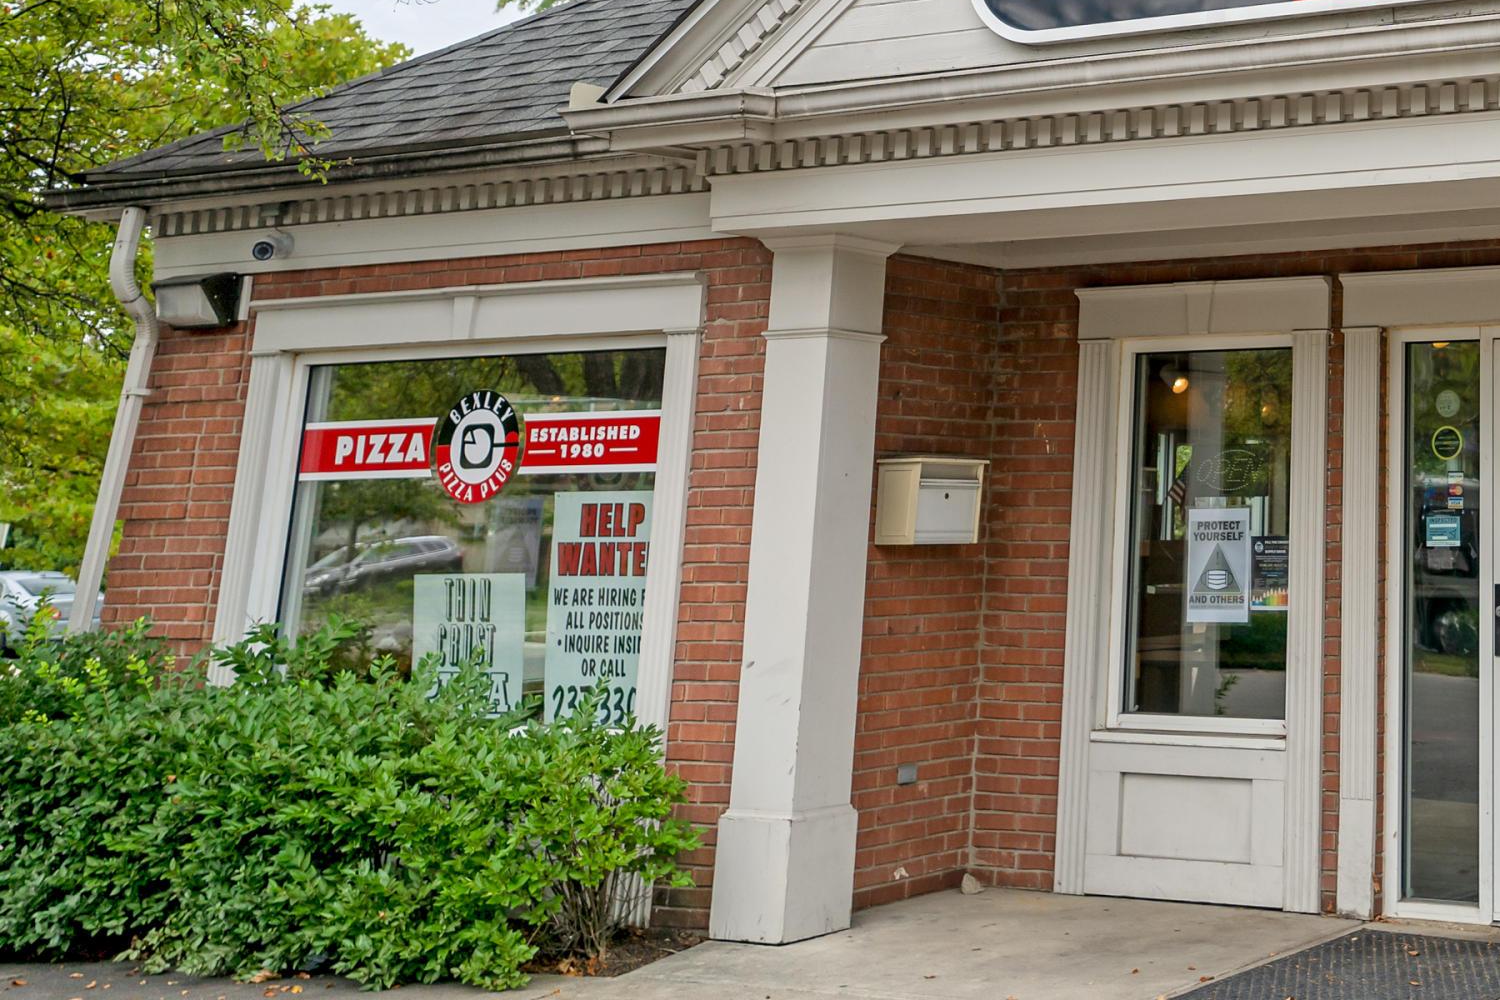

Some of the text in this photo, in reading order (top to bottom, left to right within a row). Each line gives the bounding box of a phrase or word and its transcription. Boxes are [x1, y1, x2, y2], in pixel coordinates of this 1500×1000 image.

[449, 391, 514, 425] BEXLEY
[529, 424, 641, 443] ESTABLISHED
[334, 432, 426, 466] PIZZA
[559, 442, 605, 459] 1980
[439, 458, 513, 502] PIZZA PLUS
[579, 502, 646, 538] HELP
[1197, 520, 1241, 531] PROTECT
[1193, 531, 1245, 542] YOURSELF
[557, 541, 650, 577] WANTE
[444, 577, 492, 623] THIN
[553, 587, 569, 606] WE
[571, 587, 595, 607] ARE
[598, 586, 637, 607] HIRING
[1189, 594, 1245, 605] AND OTHERS
[565, 611, 585, 631] ALL
[437, 623, 497, 667] CRUST
[564, 633, 642, 655] INQUIRE INSI
[581, 657, 627, 678] OR CALL
